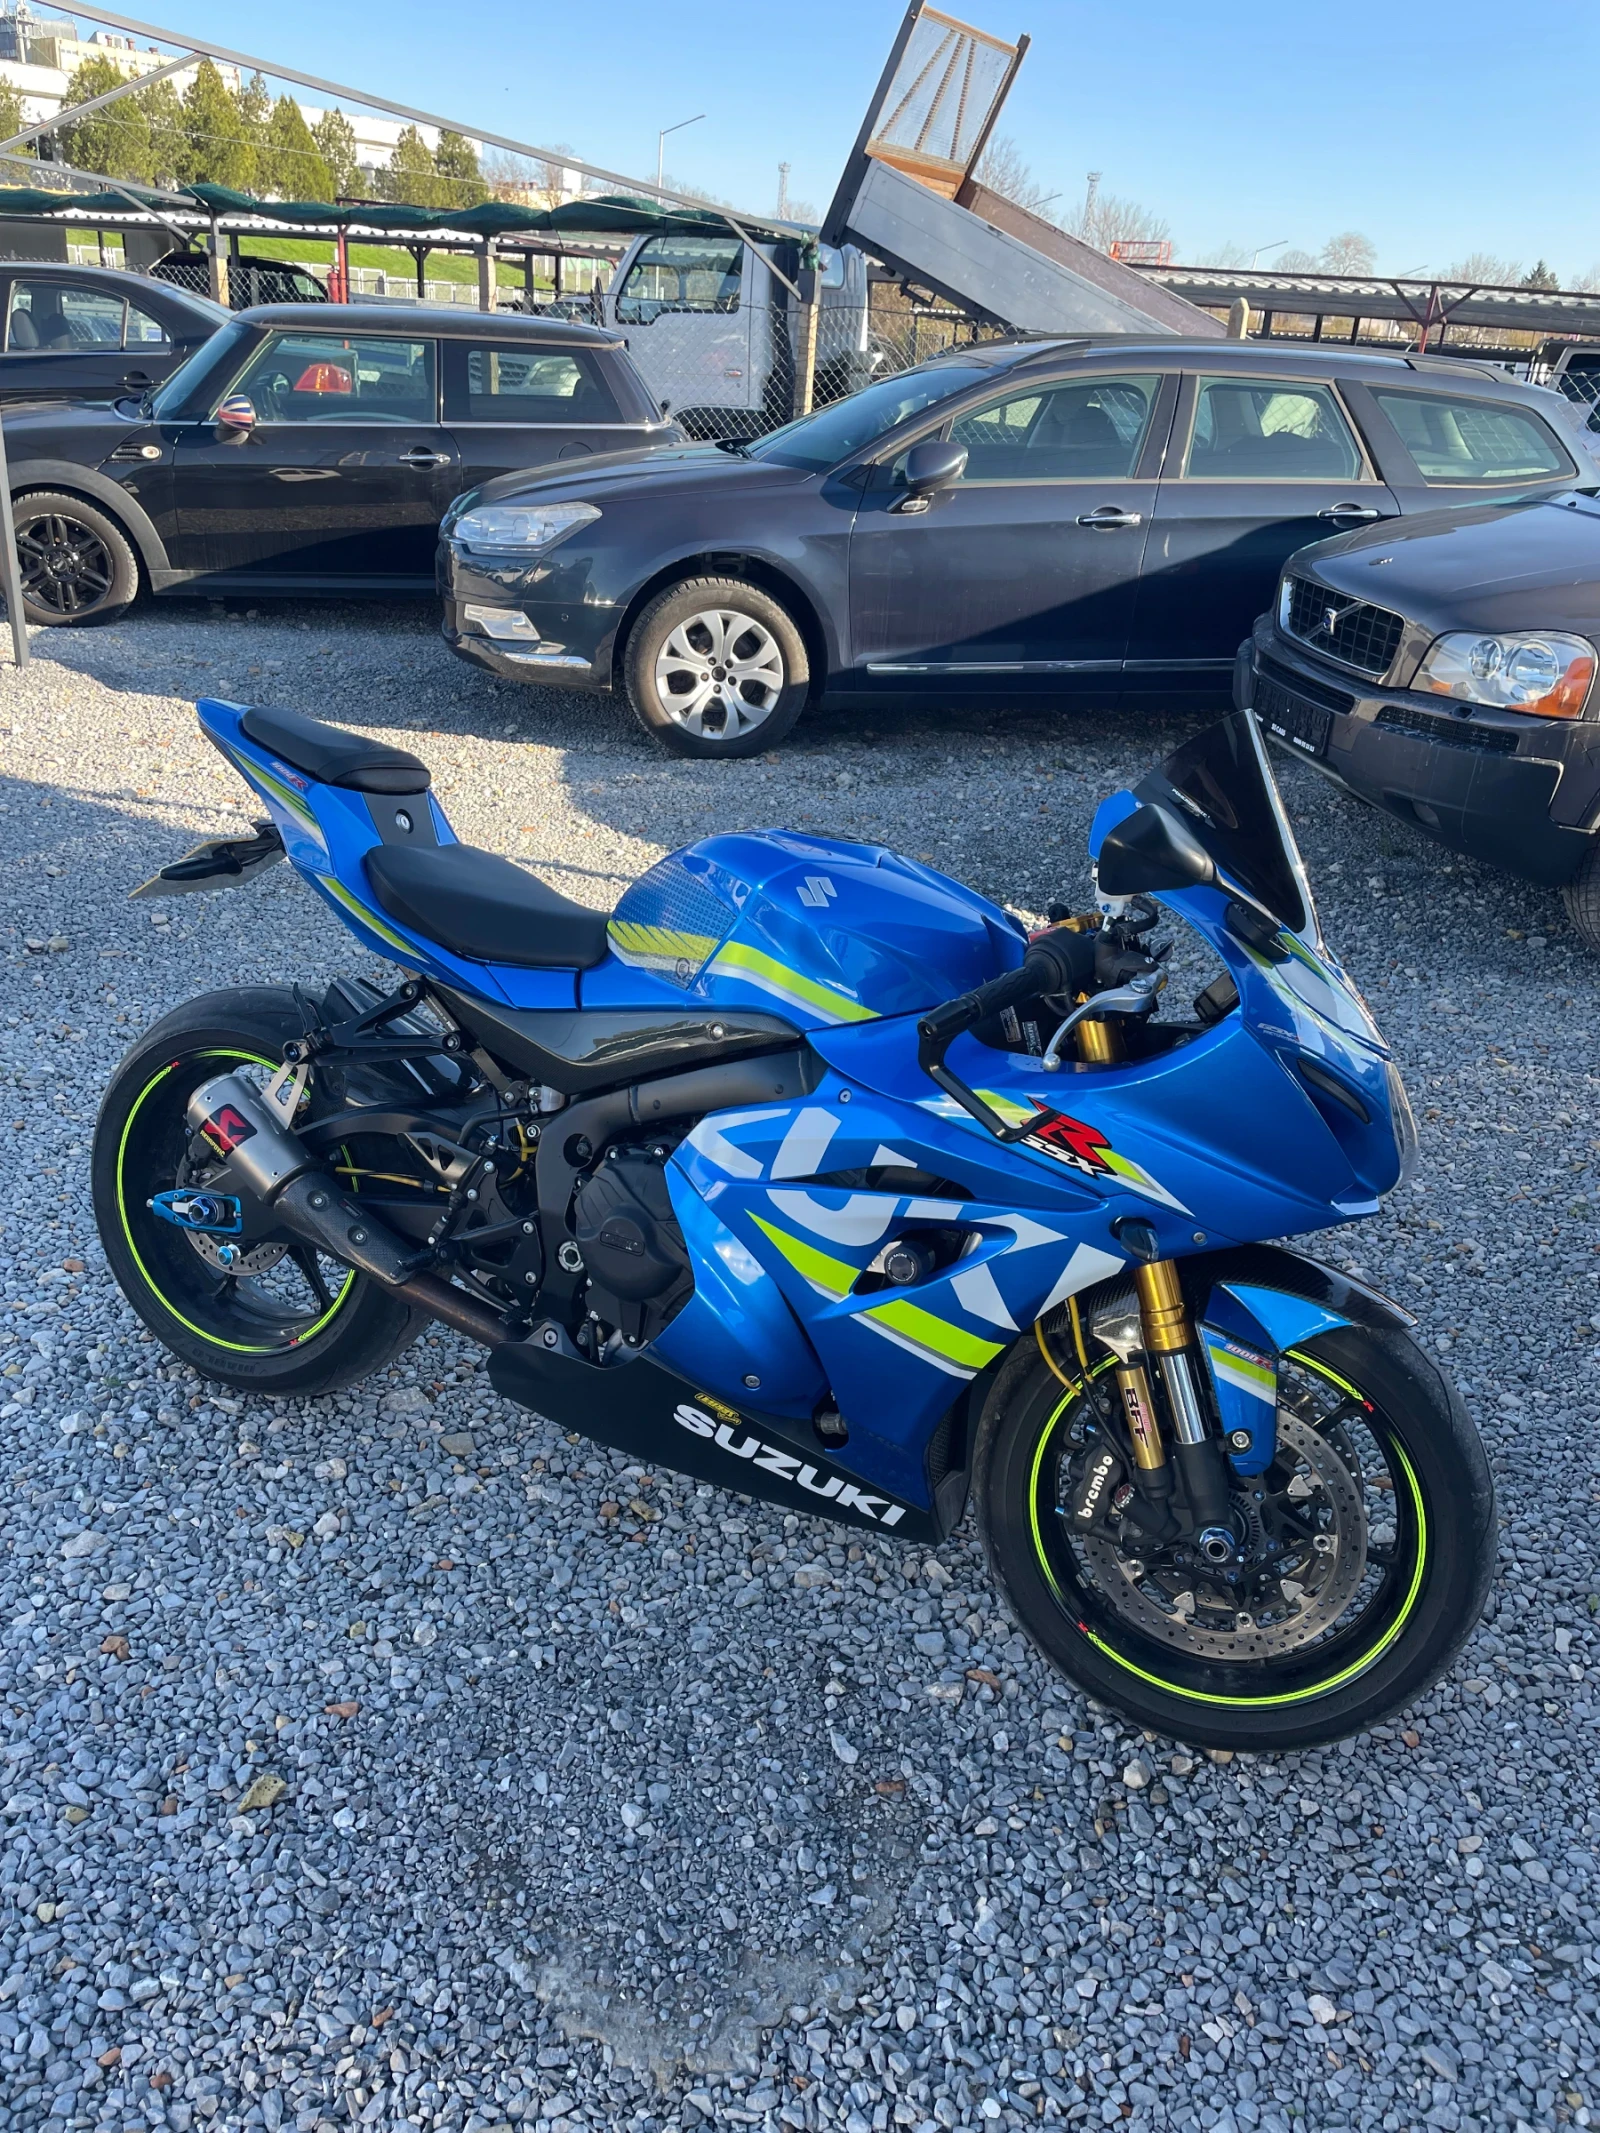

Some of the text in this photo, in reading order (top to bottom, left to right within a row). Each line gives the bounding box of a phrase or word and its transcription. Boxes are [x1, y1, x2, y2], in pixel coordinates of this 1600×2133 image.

[1224, 1342, 1275, 1371] 1000R
[672, 1403, 907, 1527] SUZUKI
[1077, 1455, 1114, 1519] brembo
